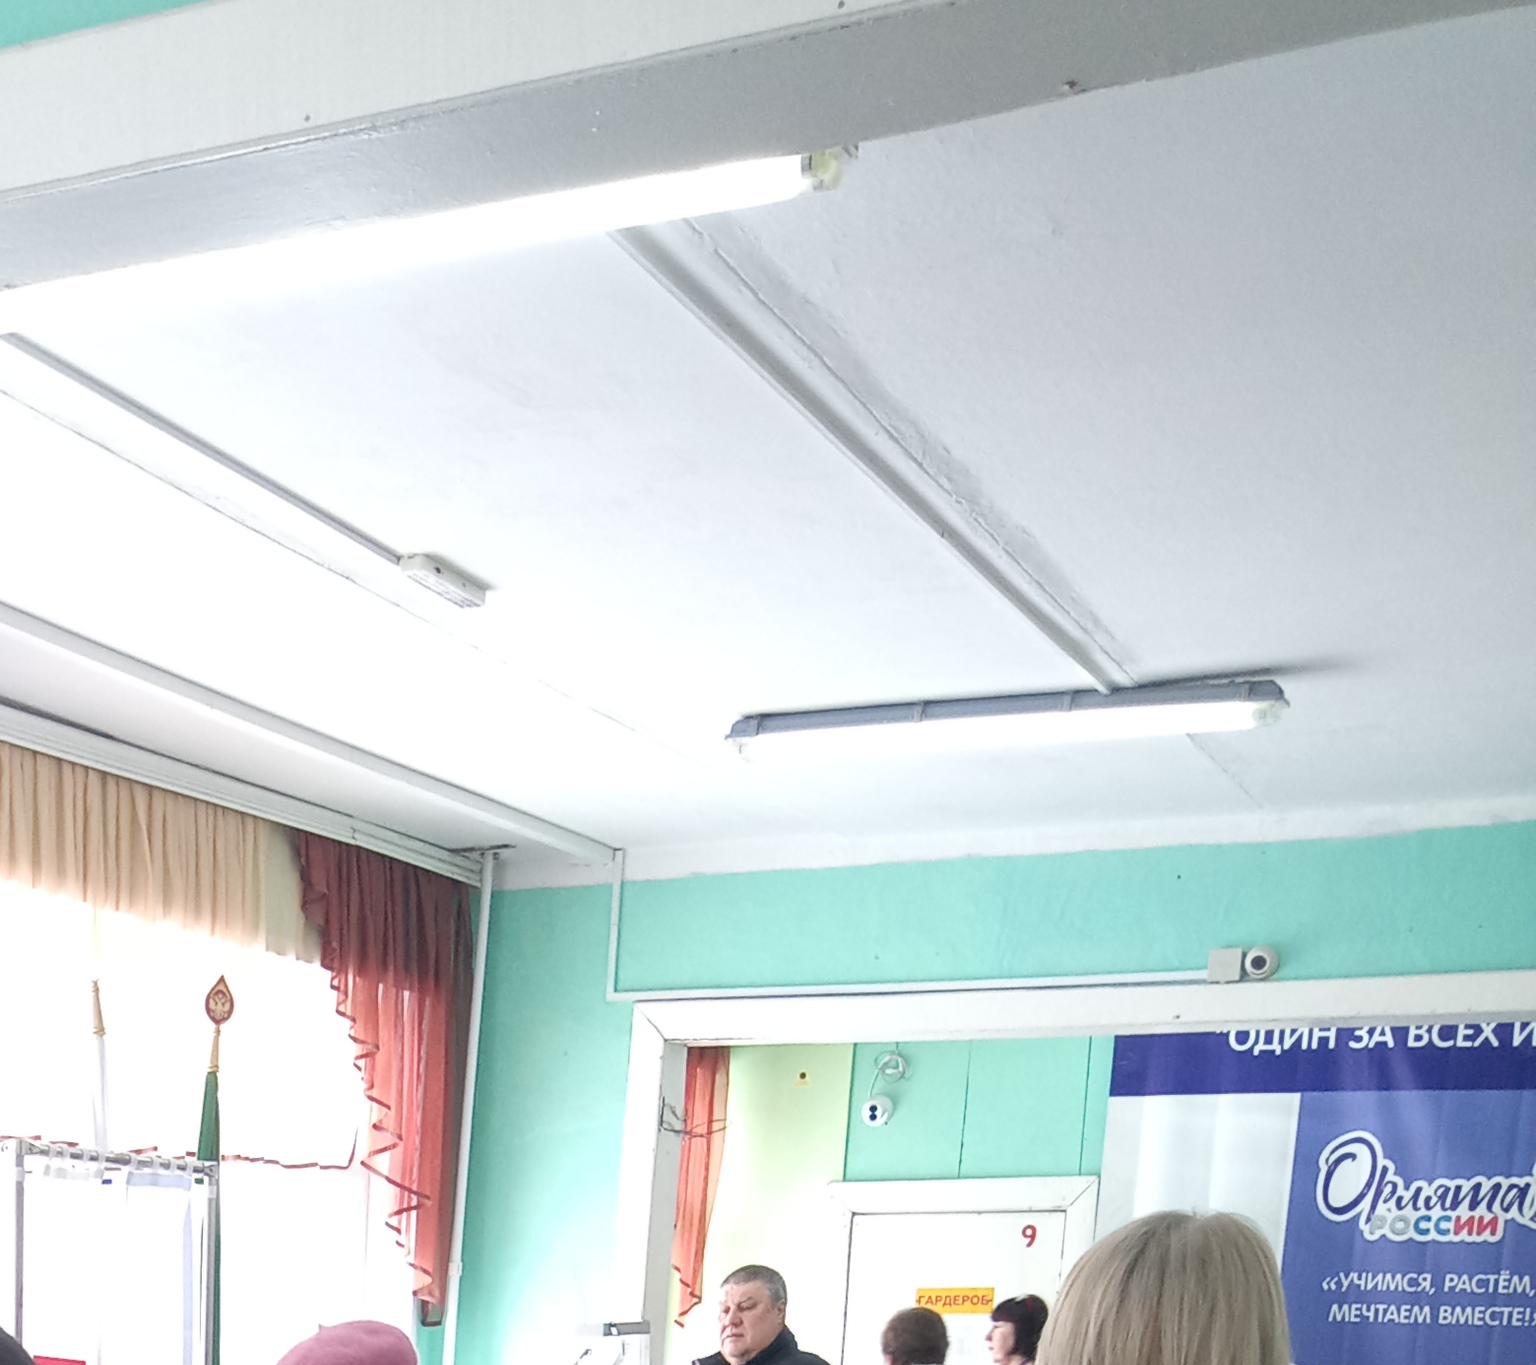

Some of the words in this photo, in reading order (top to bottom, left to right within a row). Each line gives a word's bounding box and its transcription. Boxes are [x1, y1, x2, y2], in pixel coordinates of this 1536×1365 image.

[1348, 1025, 1395, 1049] ЗА
[1407, 1023, 1500, 1048] ВСЕХ
[1322, 1136, 1532, 1225] Орлята
[1021, 1224, 1037, 1248] 9
[1369, 1214, 1499, 1237] РОССИИ
[1321, 1272, 1436, 1296] «УЧИМСЯ,
[1443, 1270, 1536, 1297] РАСТЁМ,
[917, 1294, 989, 1308] ГАРДЕРОБ
[1328, 1303, 1431, 1324] МЕЧТАЕМ
